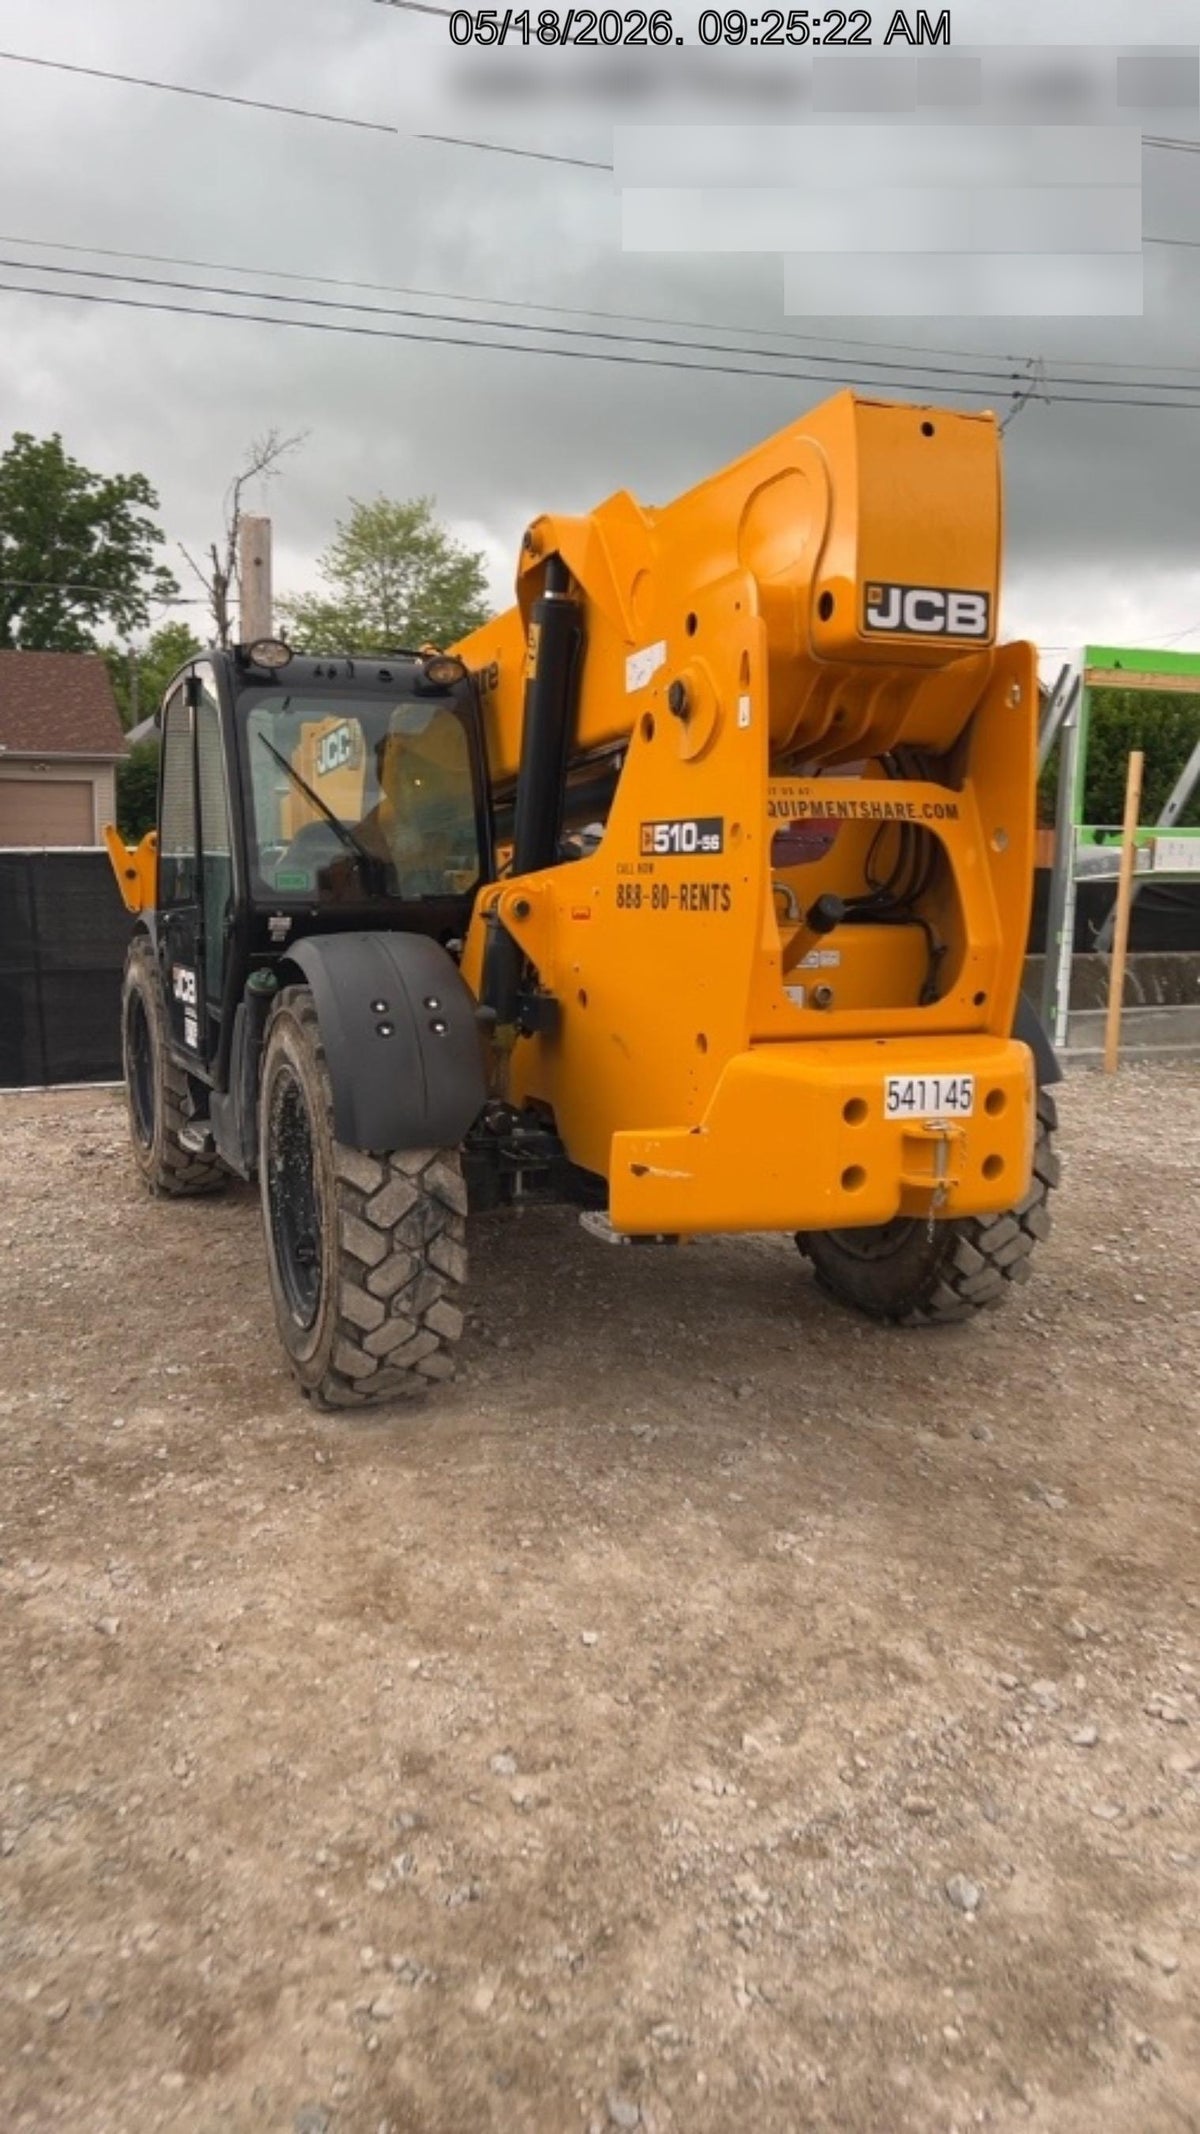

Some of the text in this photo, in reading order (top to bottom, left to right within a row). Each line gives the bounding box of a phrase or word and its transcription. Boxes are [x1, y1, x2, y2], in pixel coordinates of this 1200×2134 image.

[867, 587, 988, 635] JCB
[767, 800, 959, 820] QUIPMENTSHARE.COM
[616, 883, 732, 912] 888-80-RENTS
[887, 1079, 972, 1111] 541145
